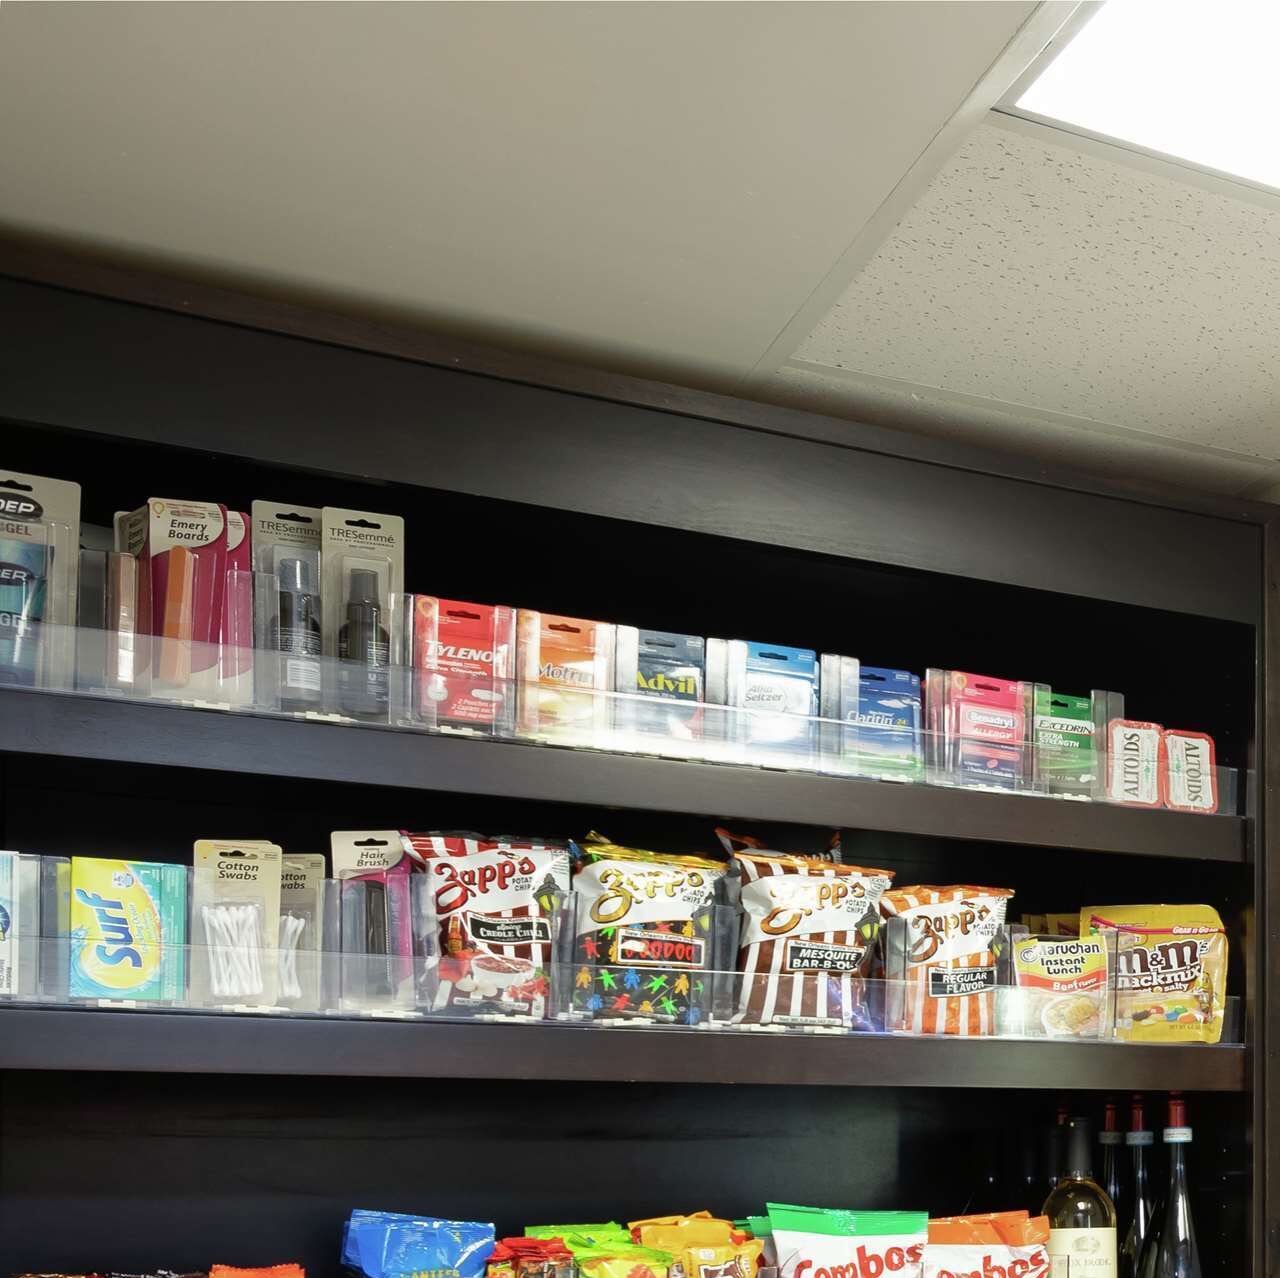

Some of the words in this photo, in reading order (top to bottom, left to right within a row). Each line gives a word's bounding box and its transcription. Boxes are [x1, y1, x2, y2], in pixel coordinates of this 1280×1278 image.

[170, 519, 207, 532] Emery
[168, 530, 209, 541] Boards
[1124, 732, 1140, 797] ALTOIDS
[1184, 741, 1202, 803] ALTOIDS
[360, 851, 385, 861] Hair
[217, 860, 259, 873] Cotton
[357, 858, 389, 868] Brush
[218, 869, 258, 882] Swabs
[75, 887, 142, 968] Surf
[799, 948, 857, 961] MESQUITE
[1041, 957, 1085, 967] Instant
[1047, 965, 1082, 974] Lunch
[942, 972, 987, 983] REGULAR
[946, 981, 984, 993] FLAVOR
